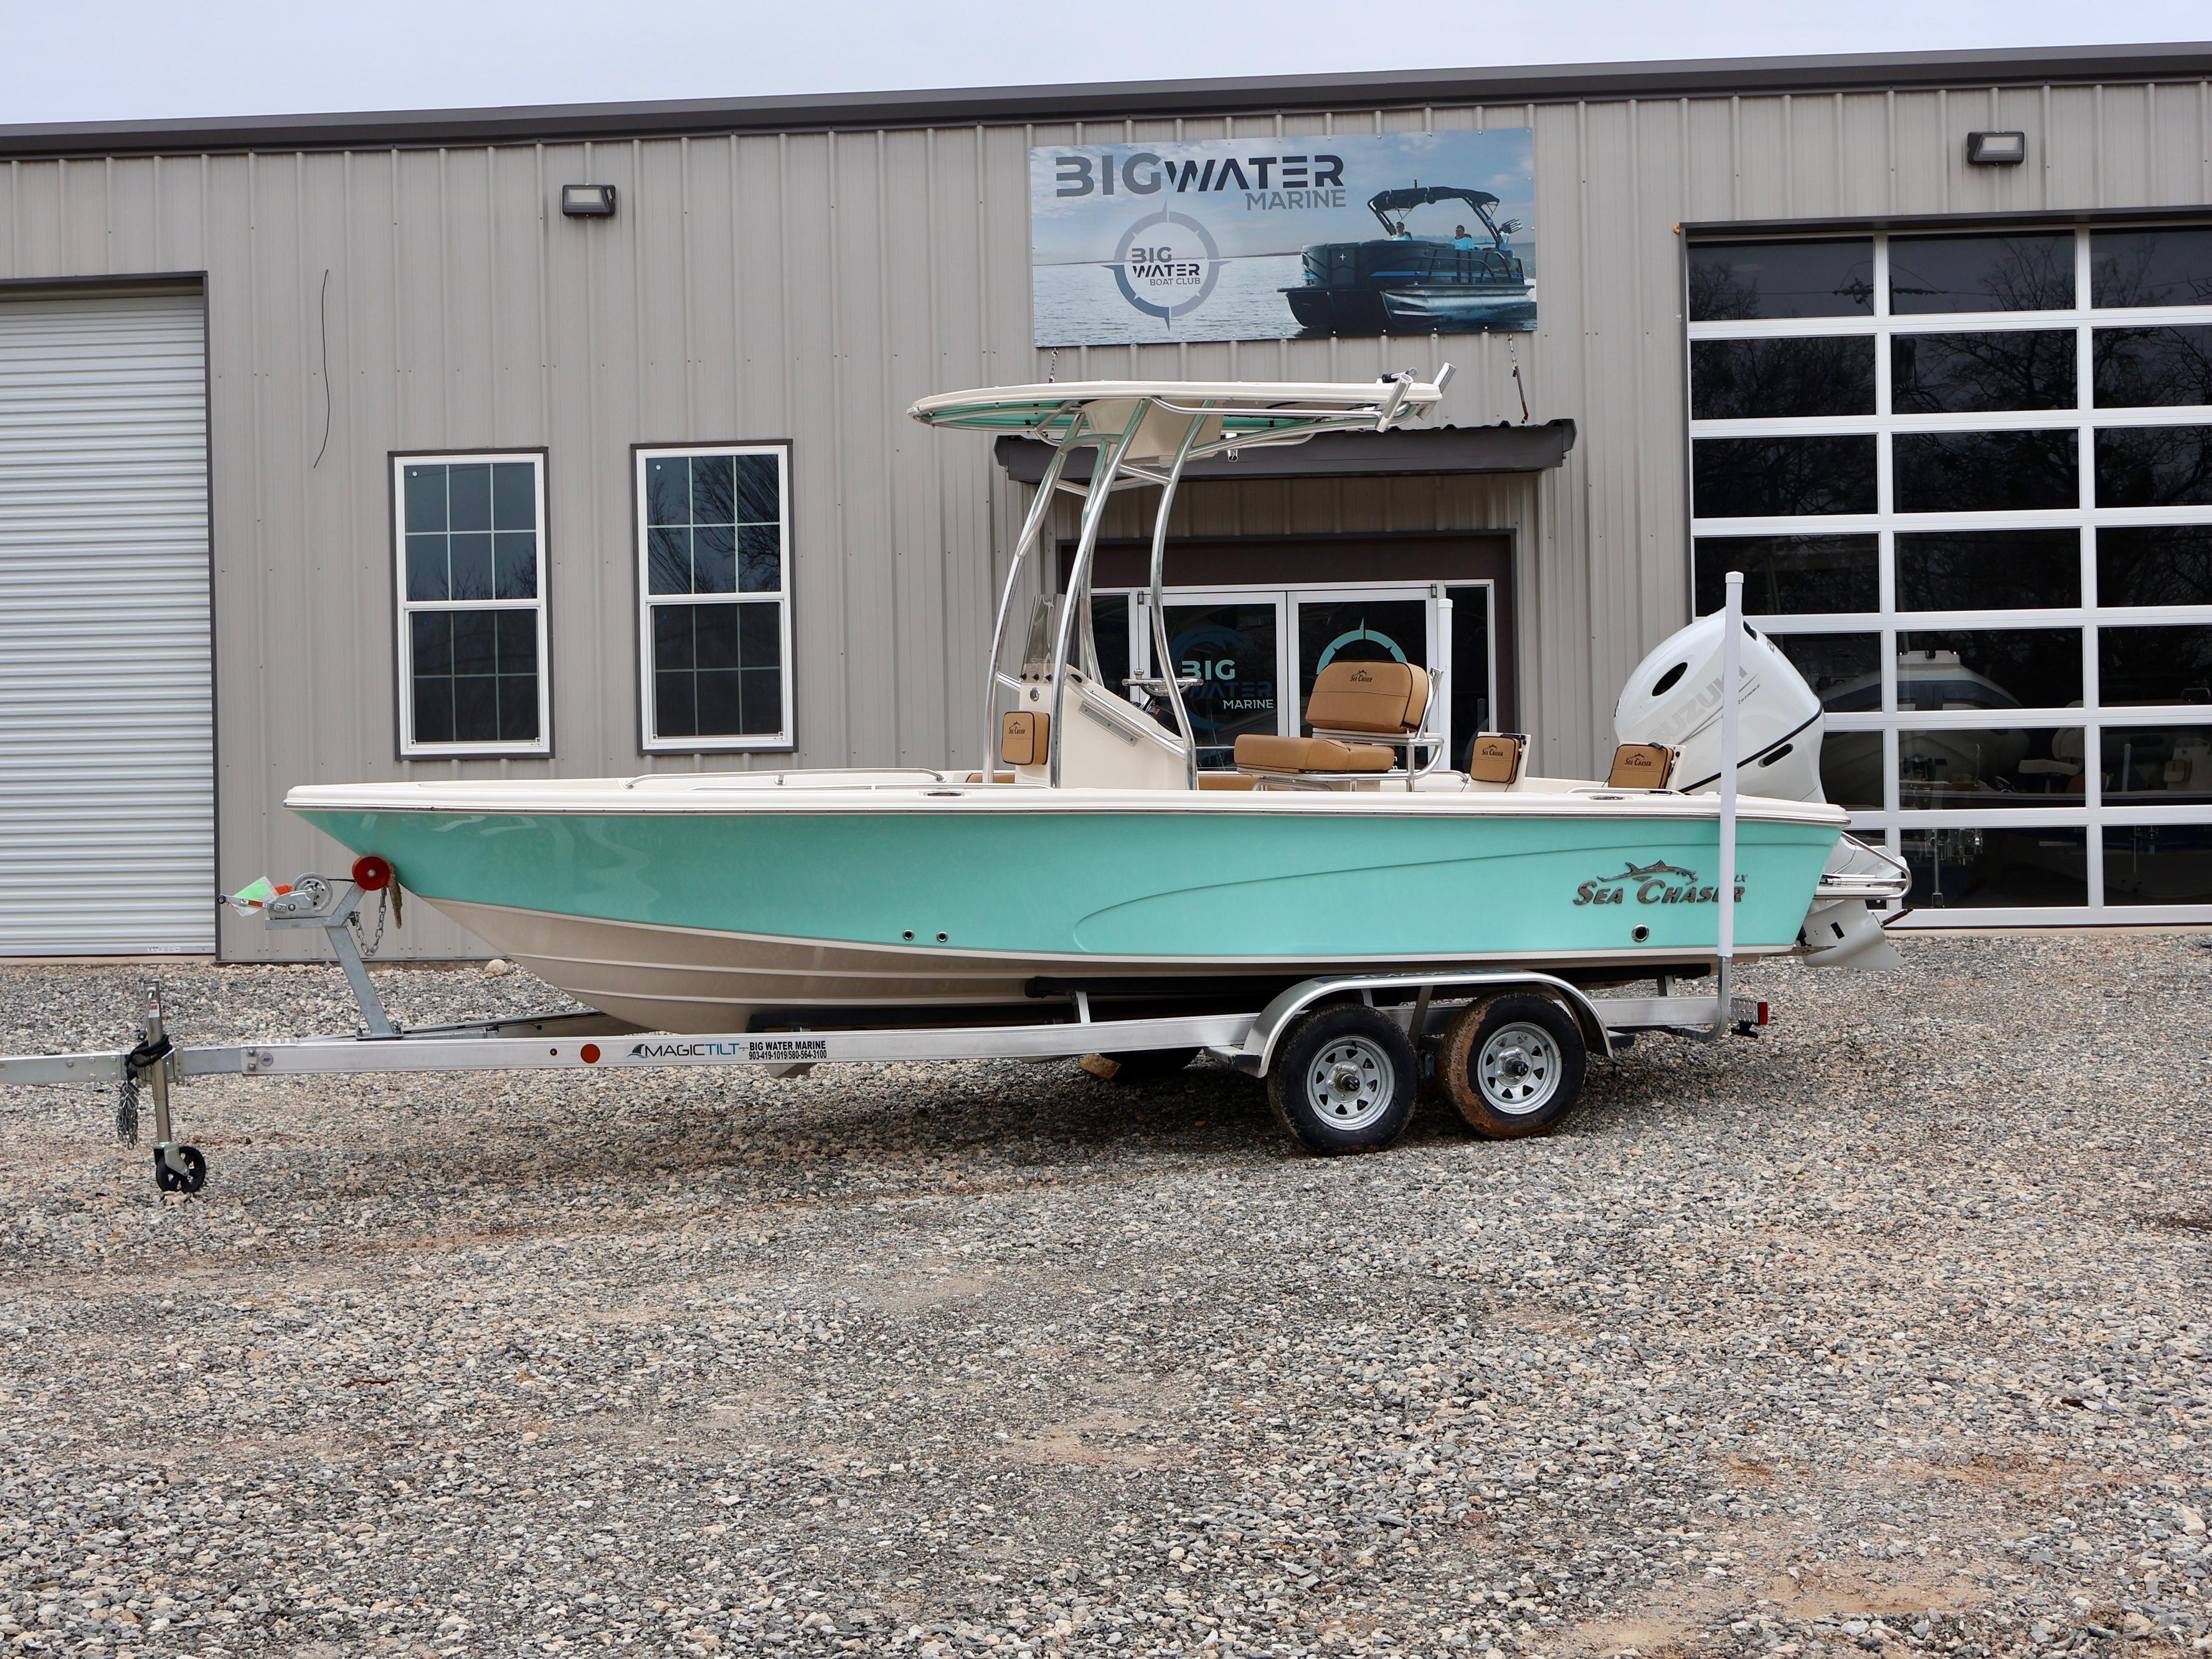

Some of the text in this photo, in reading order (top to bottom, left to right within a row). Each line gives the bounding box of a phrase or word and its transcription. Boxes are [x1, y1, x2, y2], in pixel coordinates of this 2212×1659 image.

[1245, 189, 1346, 211] MARINE
[1132, 247, 1172, 263] BIG
[1132, 263, 1200, 278] WATER
[1181, 659, 1236, 680] BIG
[1222, 699, 1274, 709] MARINE
[1572, 880, 1624, 905] SEA
[645, 1042, 740, 1057] MAGICTILT
[749, 1042, 763, 1051] BIG
[765, 1041, 793, 1051] WATER
[795, 1040, 826, 1050] MARINE
